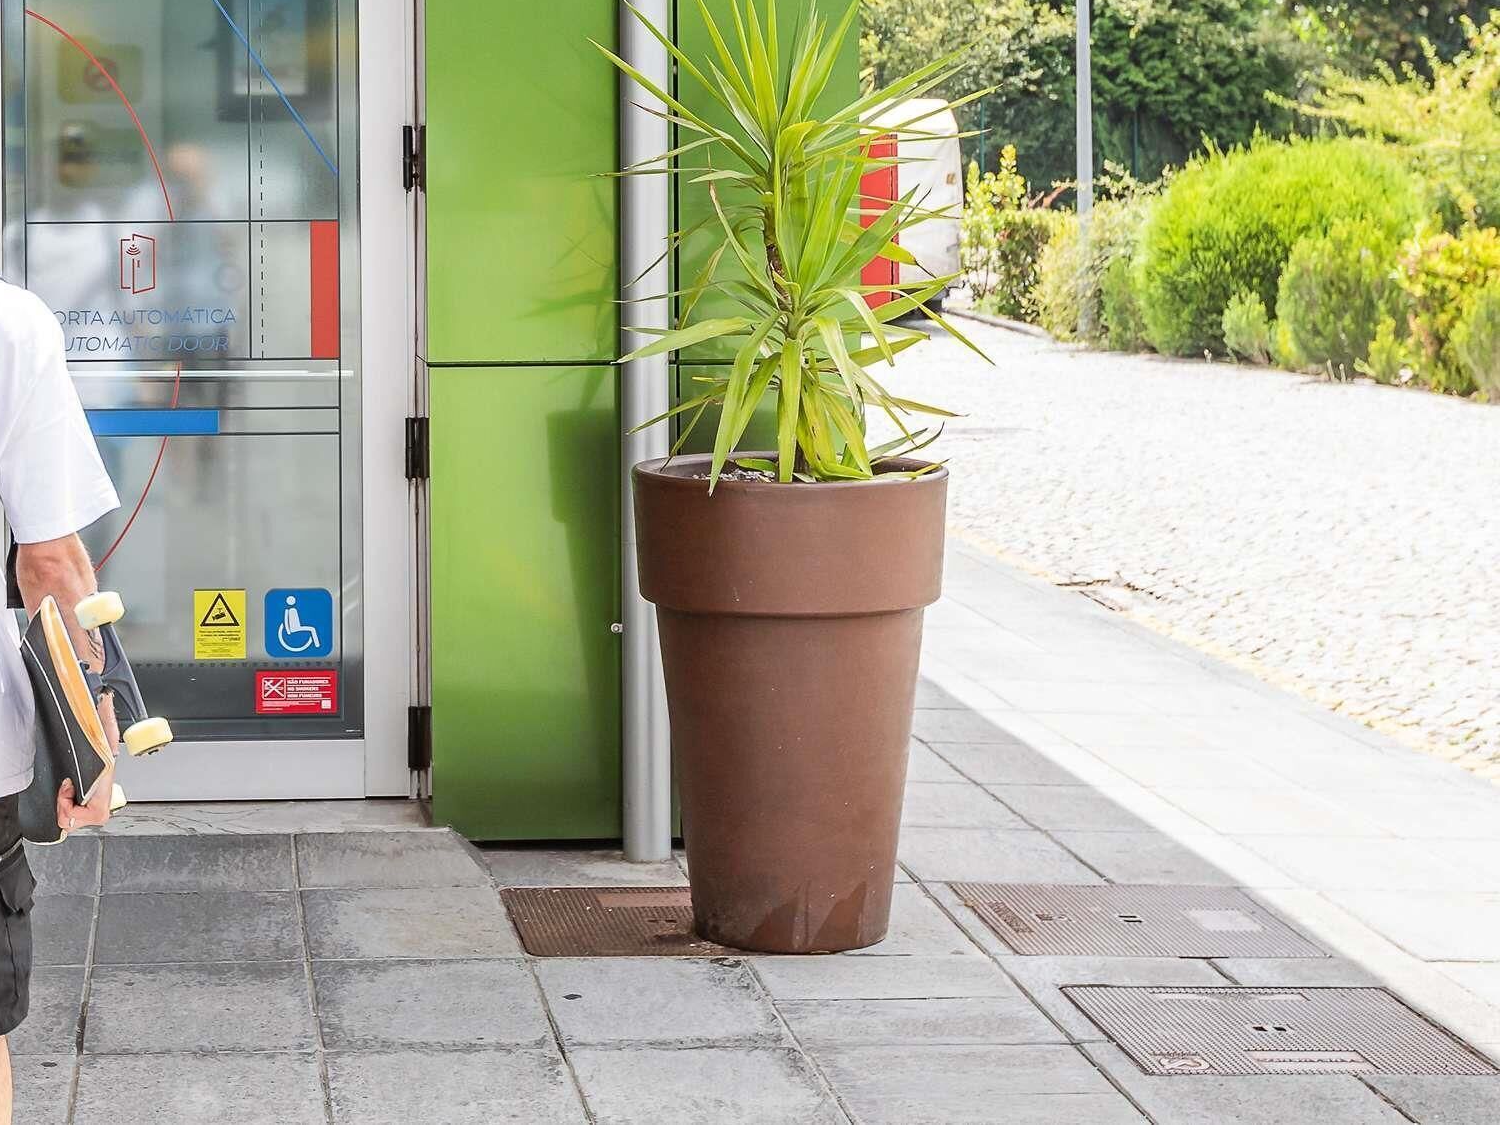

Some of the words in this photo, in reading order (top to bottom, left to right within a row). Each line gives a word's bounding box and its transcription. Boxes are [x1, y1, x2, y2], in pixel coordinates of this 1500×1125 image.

[52, 310, 104, 326] ORTA
[108, 306, 237, 326] AUTOMÁTICA
[64, 335, 162, 352] UTOMATIC
[167, 335, 229, 352] DOOR
